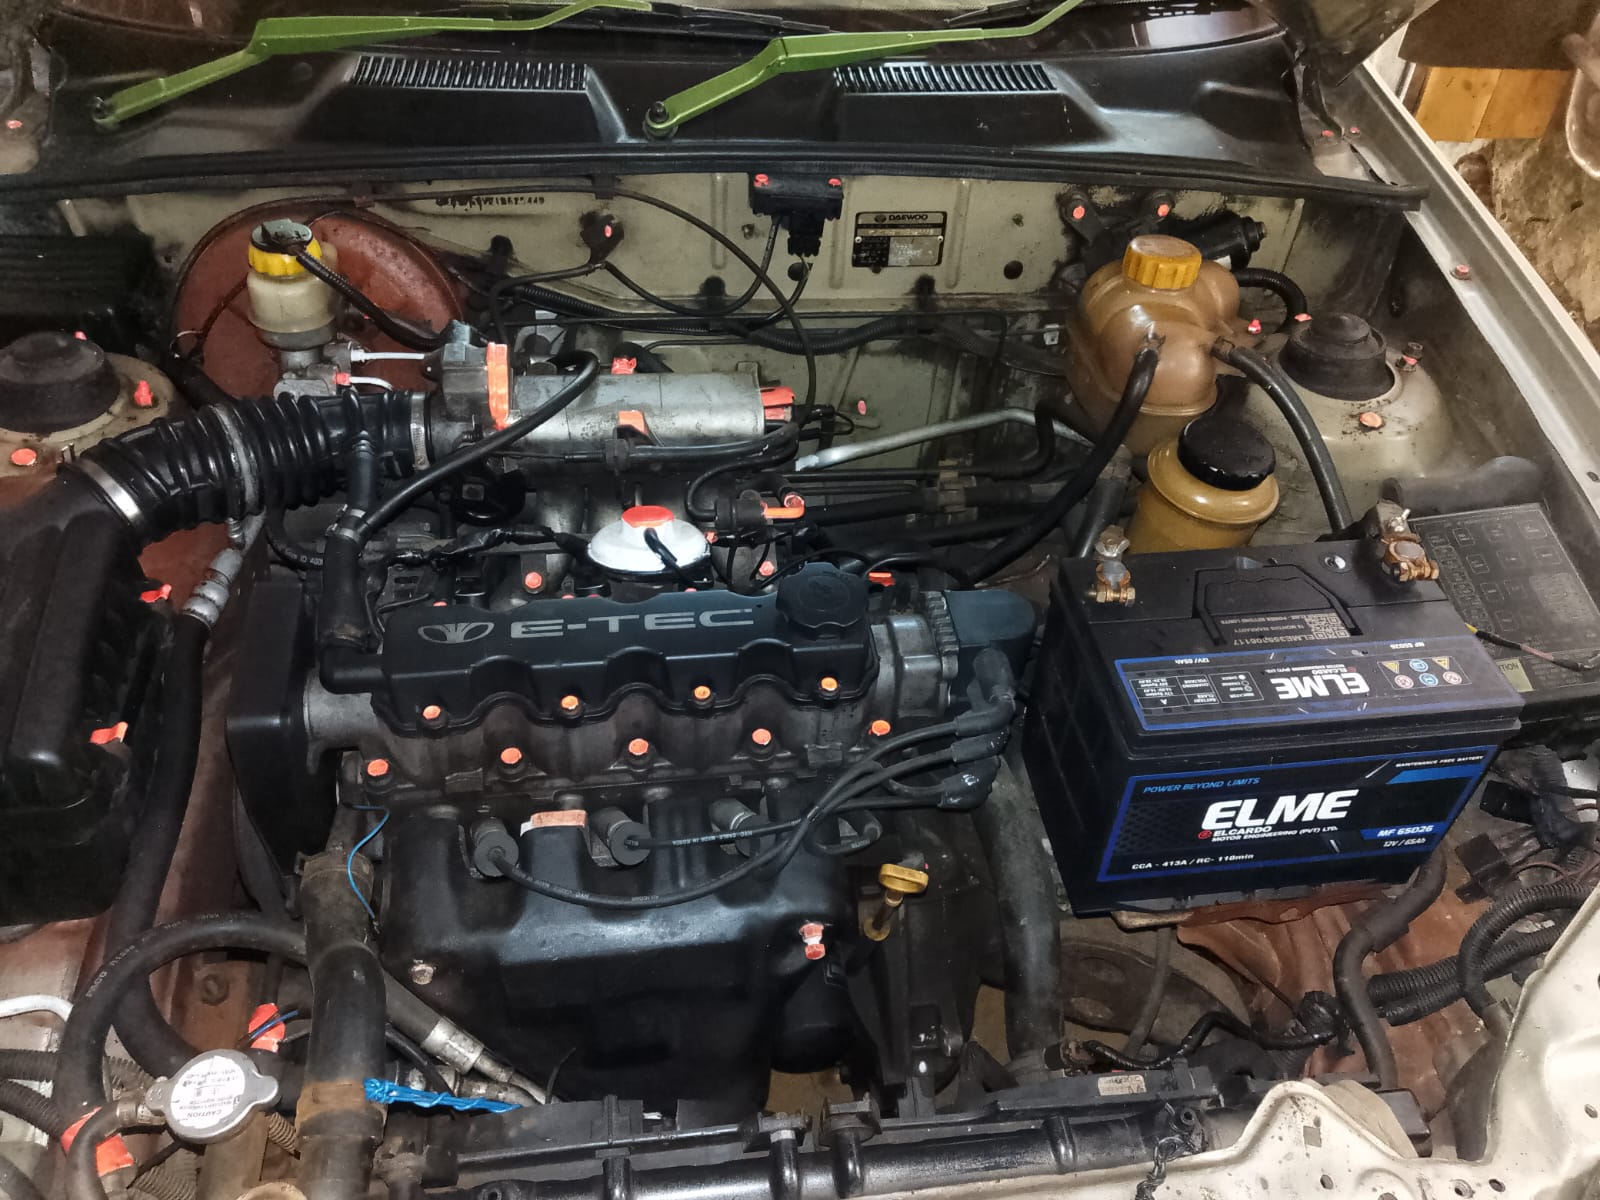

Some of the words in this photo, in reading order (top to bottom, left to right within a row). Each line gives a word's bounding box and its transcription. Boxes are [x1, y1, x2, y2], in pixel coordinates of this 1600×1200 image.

[511, 608, 754, 639] E-TEC
[1270, 673, 1370, 700] ELME
[1143, 784, 1181, 794] POWER
[1182, 781, 1225, 790] BEYOND
[1227, 778, 1261, 787] LIMITS
[1201, 789, 1359, 831] ELME
[1211, 834, 1242, 842] MOTOR
[1243, 830, 1298, 840] ENGINEERING
[1213, 825, 1273, 837] ELCARDO
[1377, 828, 1396, 837] MF
[1397, 825, 1434, 835] 65D26
[1131, 862, 1153, 870] CCA
[1162, 859, 1187, 867] 413A
[187, 1109, 222, 1118] CAUTION
